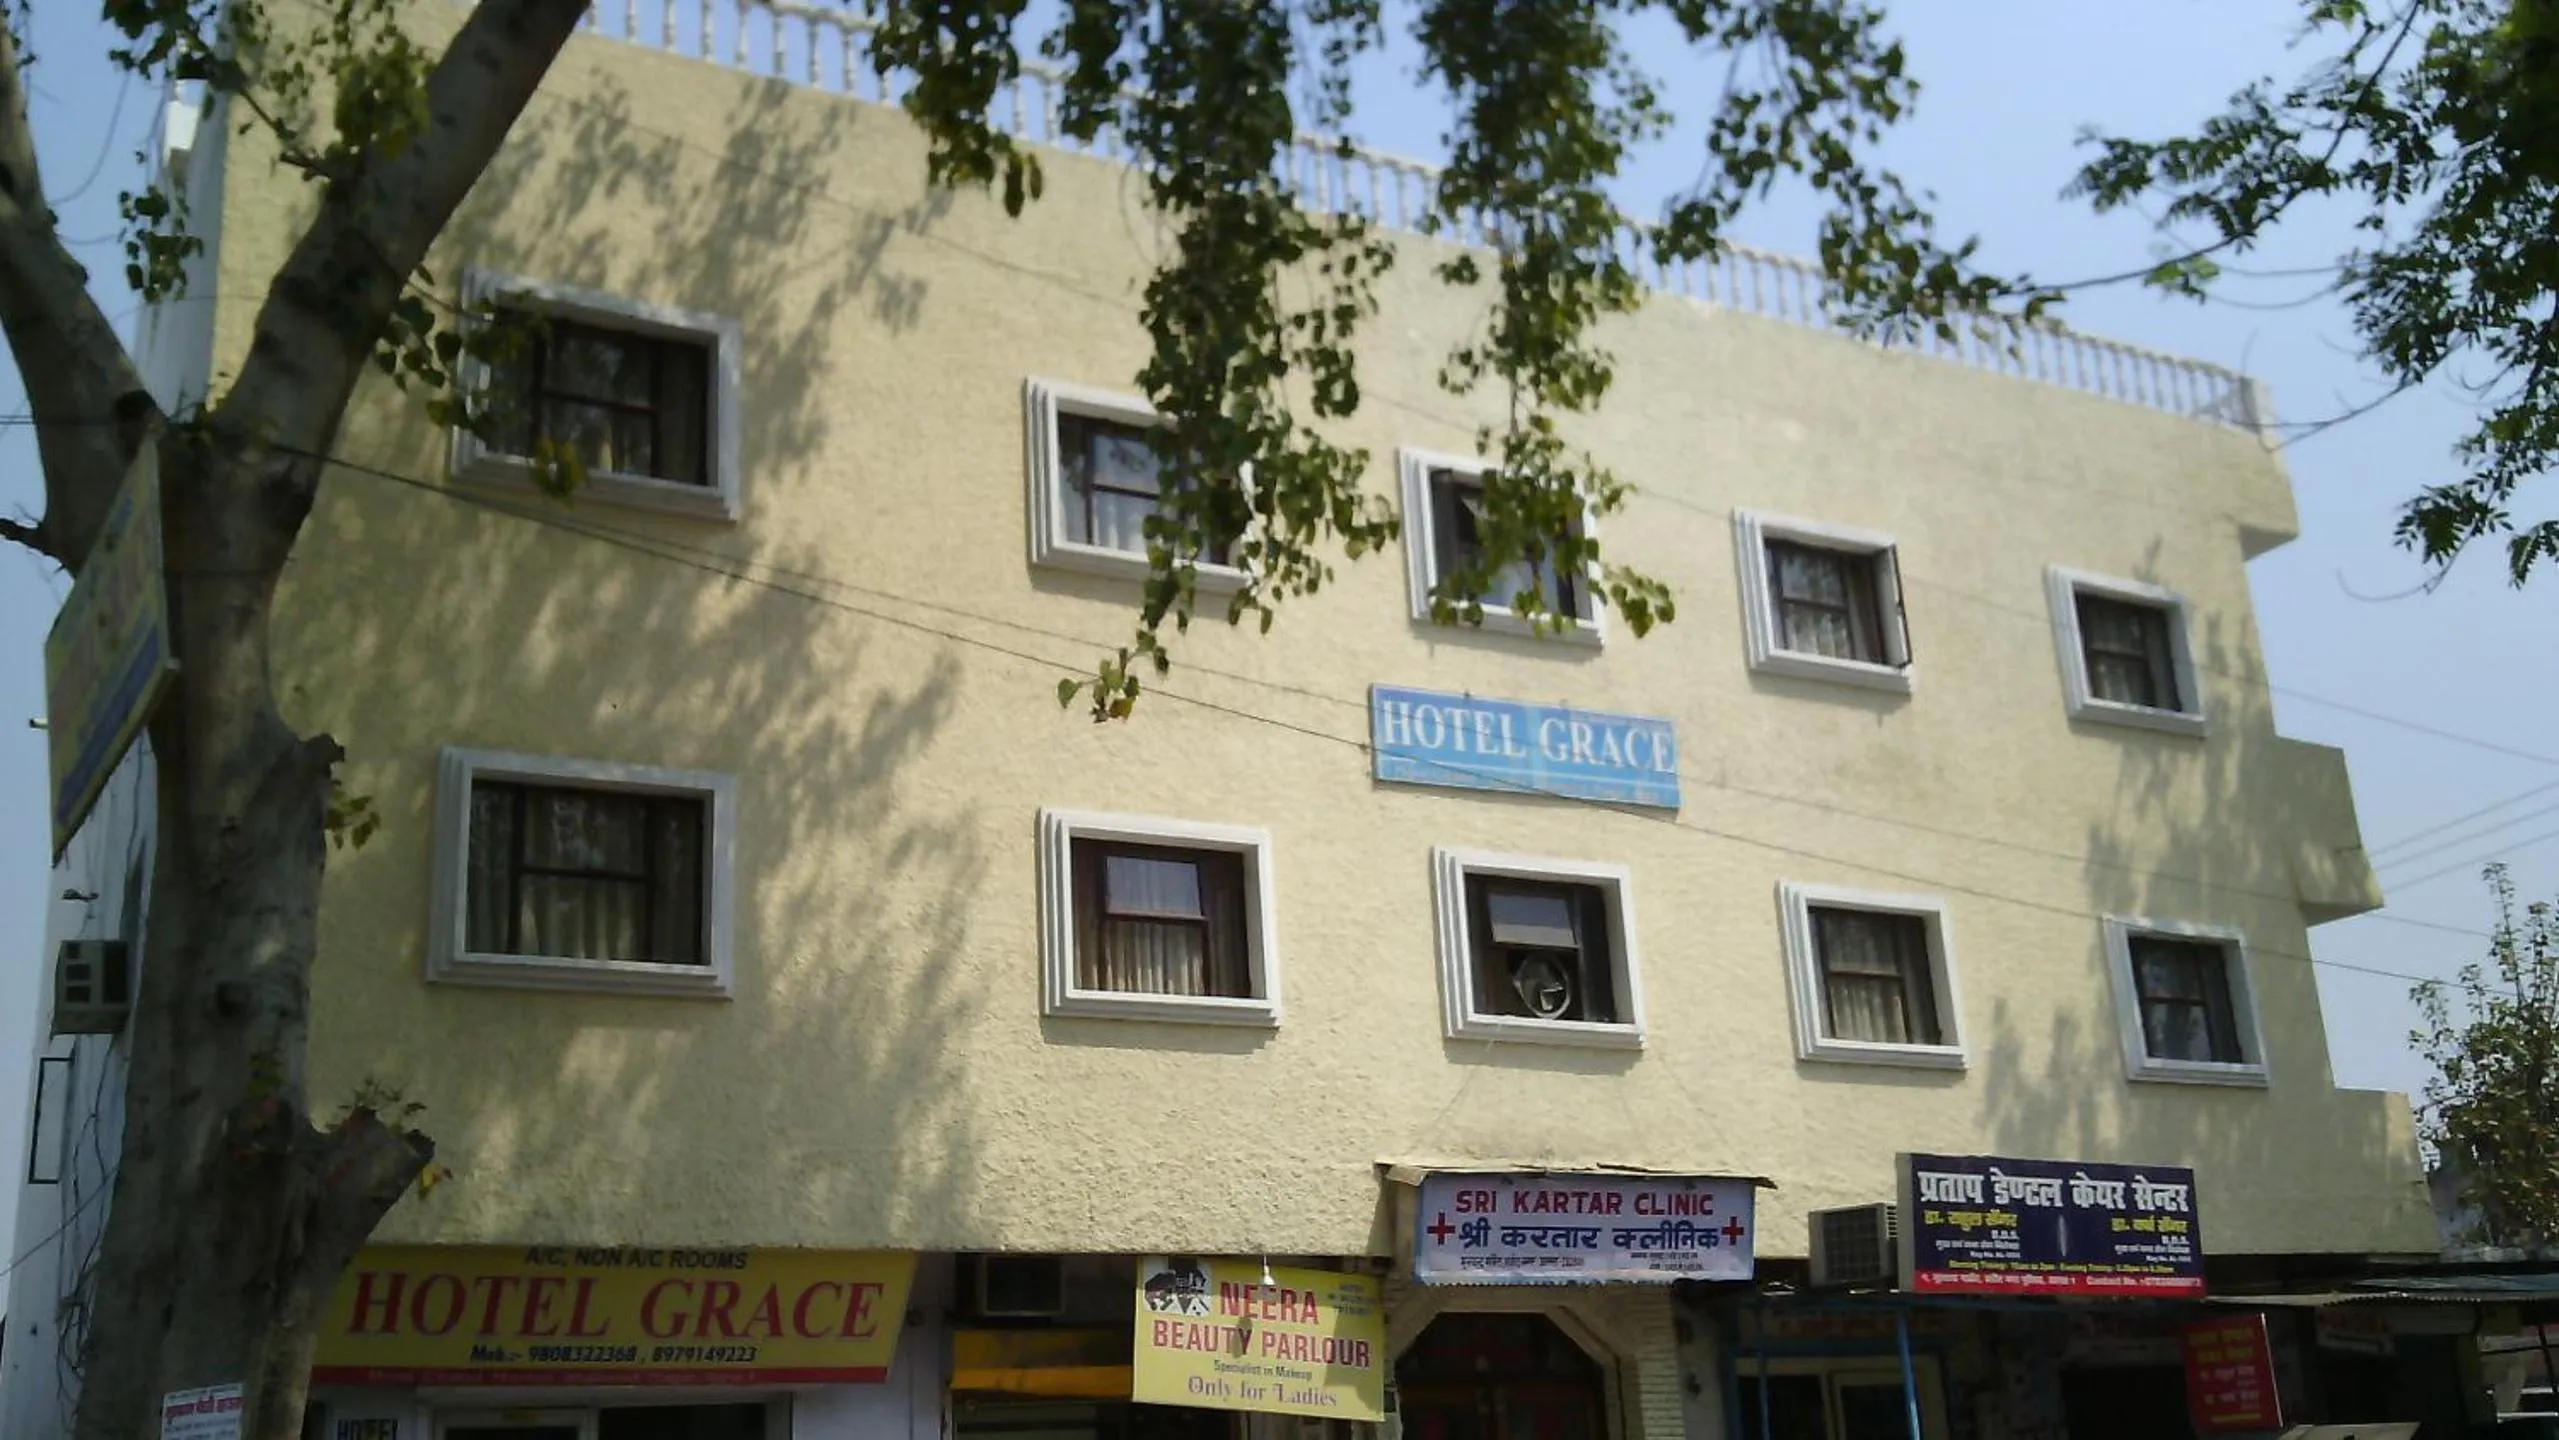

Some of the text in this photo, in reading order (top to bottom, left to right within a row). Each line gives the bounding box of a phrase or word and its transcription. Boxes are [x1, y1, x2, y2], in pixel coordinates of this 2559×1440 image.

[1382, 699, 1675, 774] HOTEL GRACE
[1456, 1190, 1715, 1216] SRI KARTAR CLINIC
[1917, 1166, 2189, 1212] प्रताप डेण्टल केयर सेन्टर
[1458, 1216, 1720, 1250] श्री करतार क्लीनिक
[575, 1247, 622, 1267] NON
[627, 1248, 663, 1268] A/C
[669, 1250, 748, 1269] ROOMS
[347, 1271, 885, 1339] HOTEL GRACE
[1219, 1280, 1320, 1326] NEERA
[1153, 1318, 1370, 1368] BEAUTY PARLOUR
[1188, 1375, 1338, 1407] Only for Ladies
